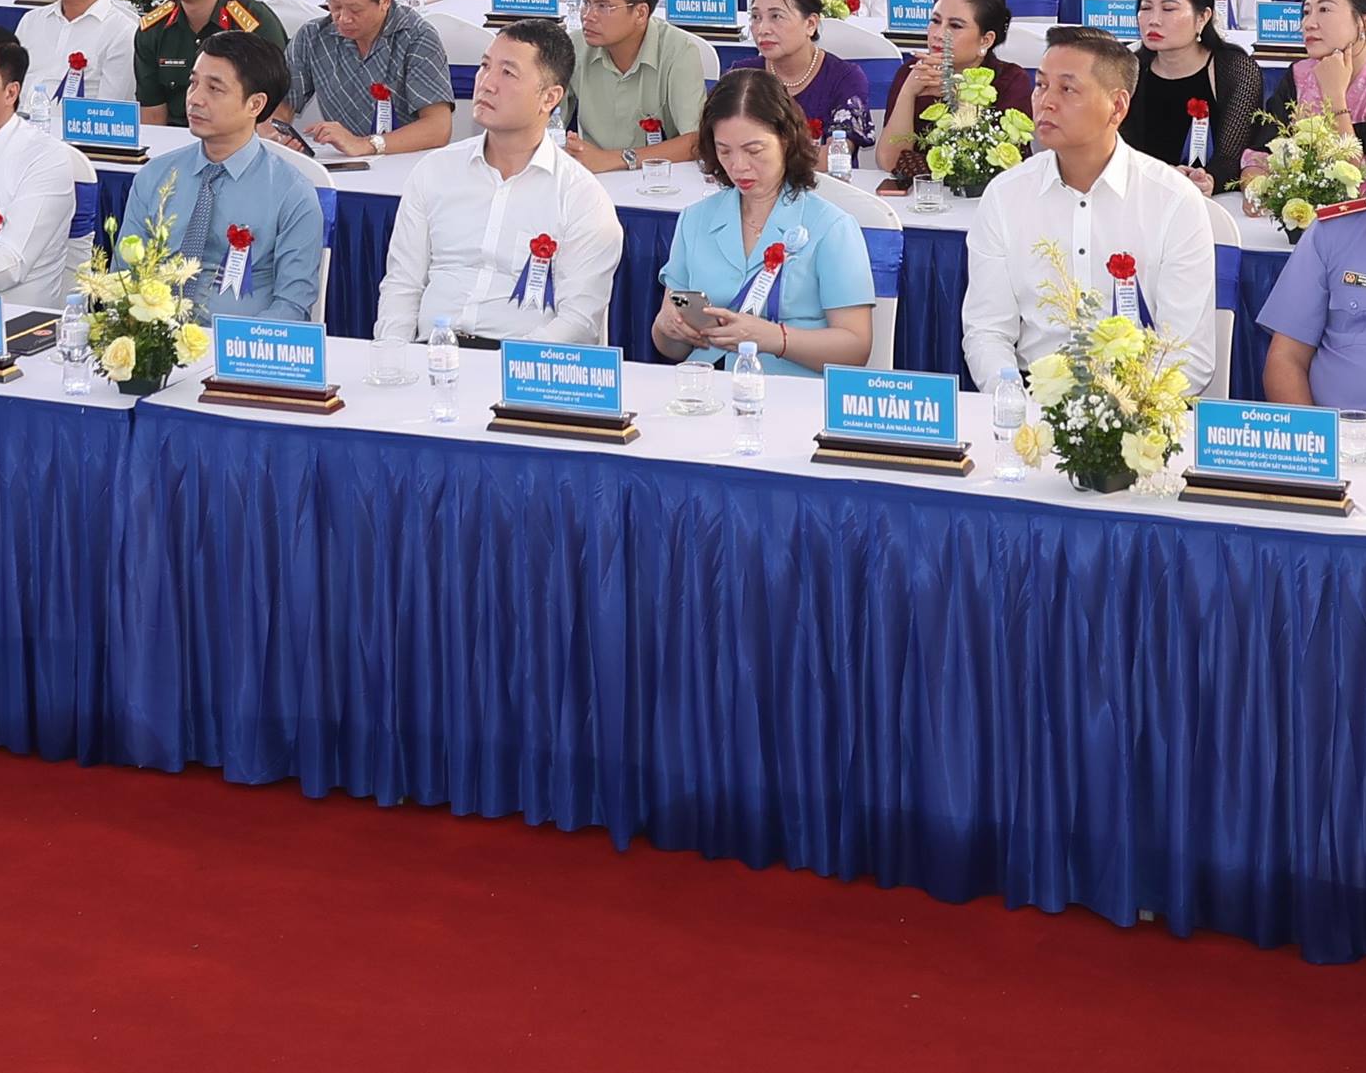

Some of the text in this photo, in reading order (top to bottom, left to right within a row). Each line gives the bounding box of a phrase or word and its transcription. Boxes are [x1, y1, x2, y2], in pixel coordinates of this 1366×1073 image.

[67, 117, 81, 134] CÁC
[111, 120, 135, 138] NGÀNH
[250, 325, 288, 337] ĐỒNG CHÍ
[226, 336, 315, 366] BÙI VĂN MẠNH
[540, 348, 581, 362] ĐỒNG CHÍ
[509, 359, 615, 391] PHẠM THỊ PHƯƠNG HẠNH
[868, 376, 913, 391] ĐỒNG CHÍ
[843, 393, 939, 423] MAI VĂN TÀI
[1241, 408, 1291, 423] ĐỒNG CHÍ
[1207, 422, 1326, 457] NGUYỄN VĂN VIỆN
